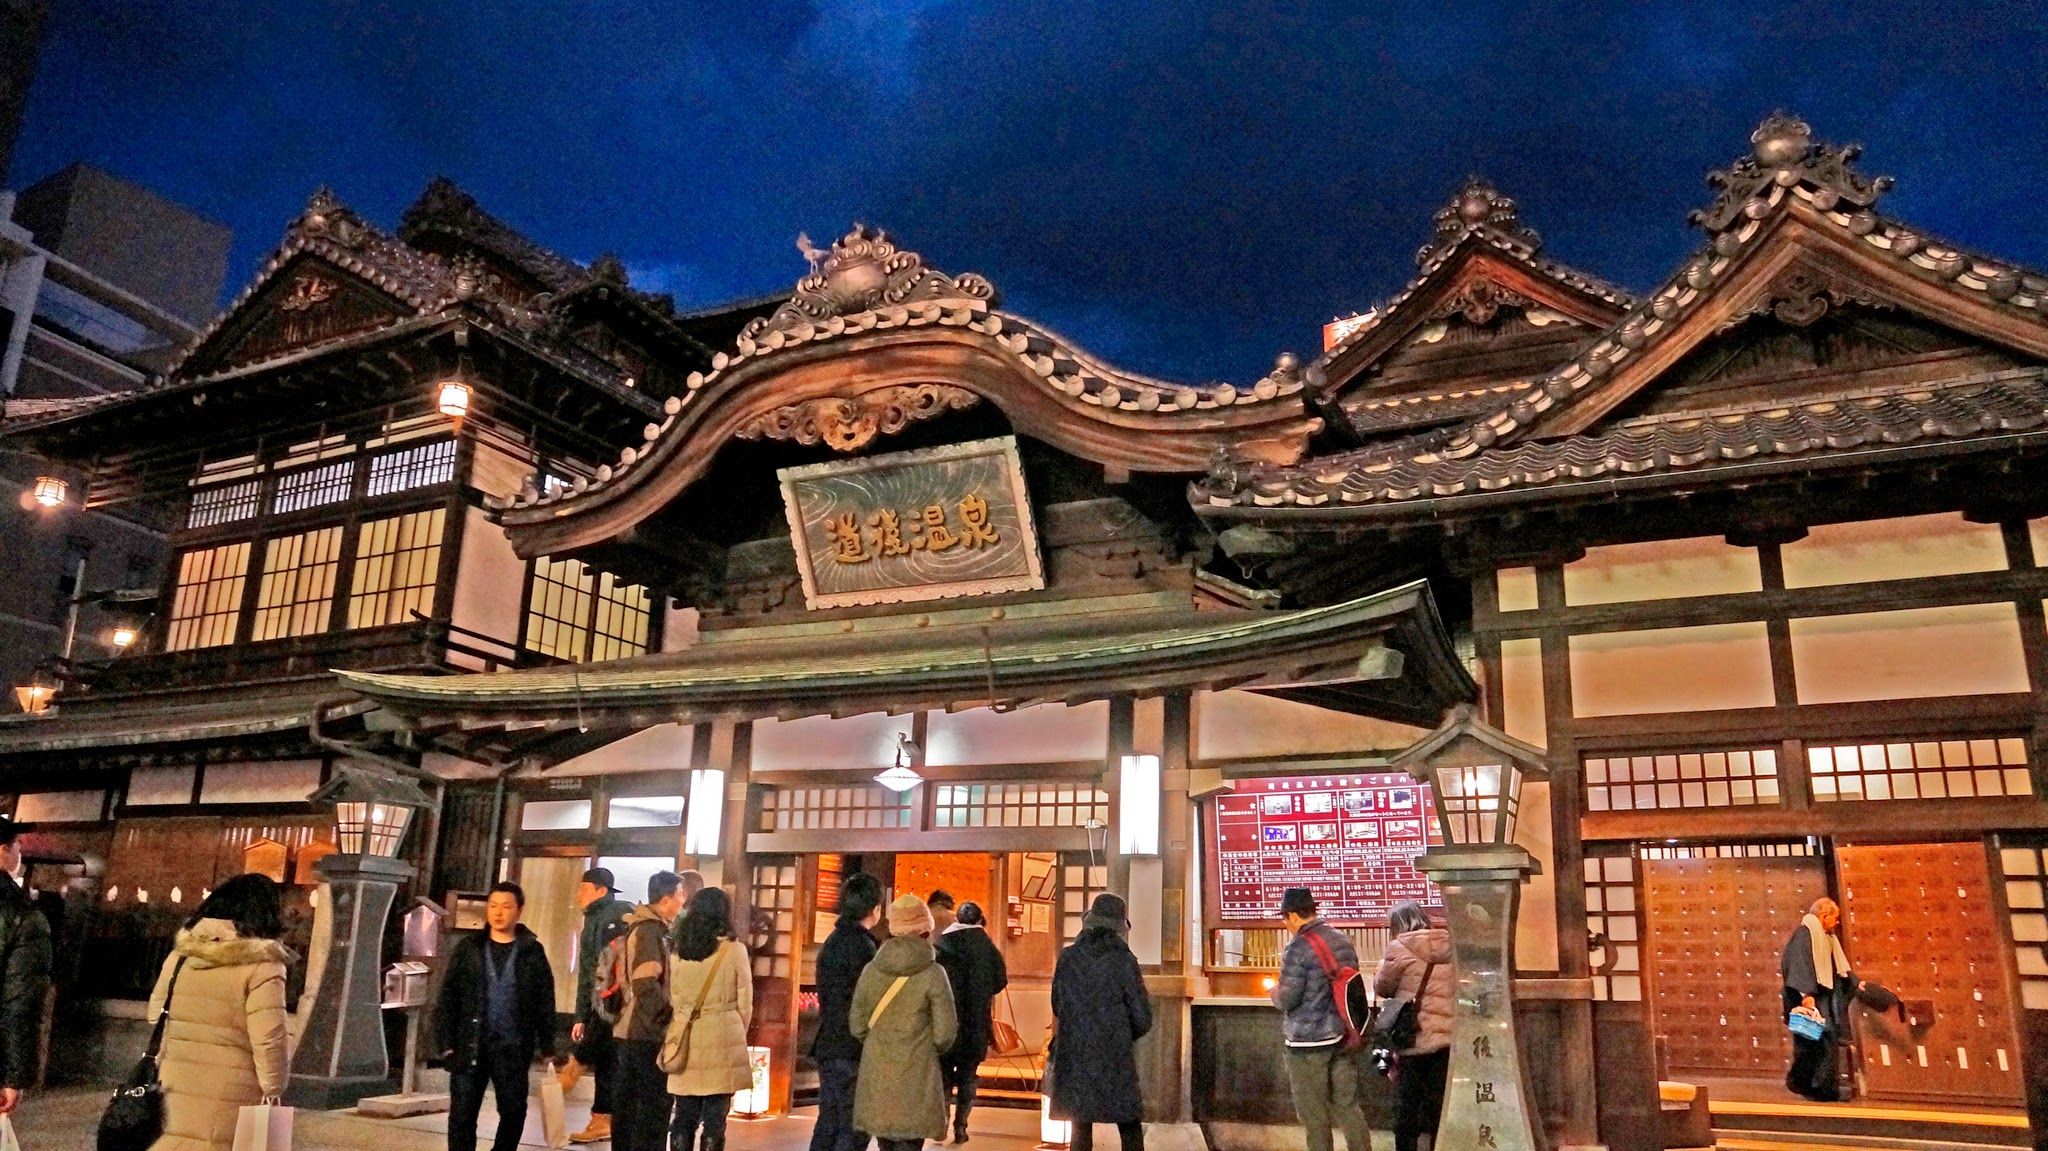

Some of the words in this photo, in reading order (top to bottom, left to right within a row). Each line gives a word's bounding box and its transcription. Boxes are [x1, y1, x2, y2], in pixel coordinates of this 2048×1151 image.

[824, 494, 1000, 563] 道後温泉
[1471, 991, 1498, 1149] 後温泉
